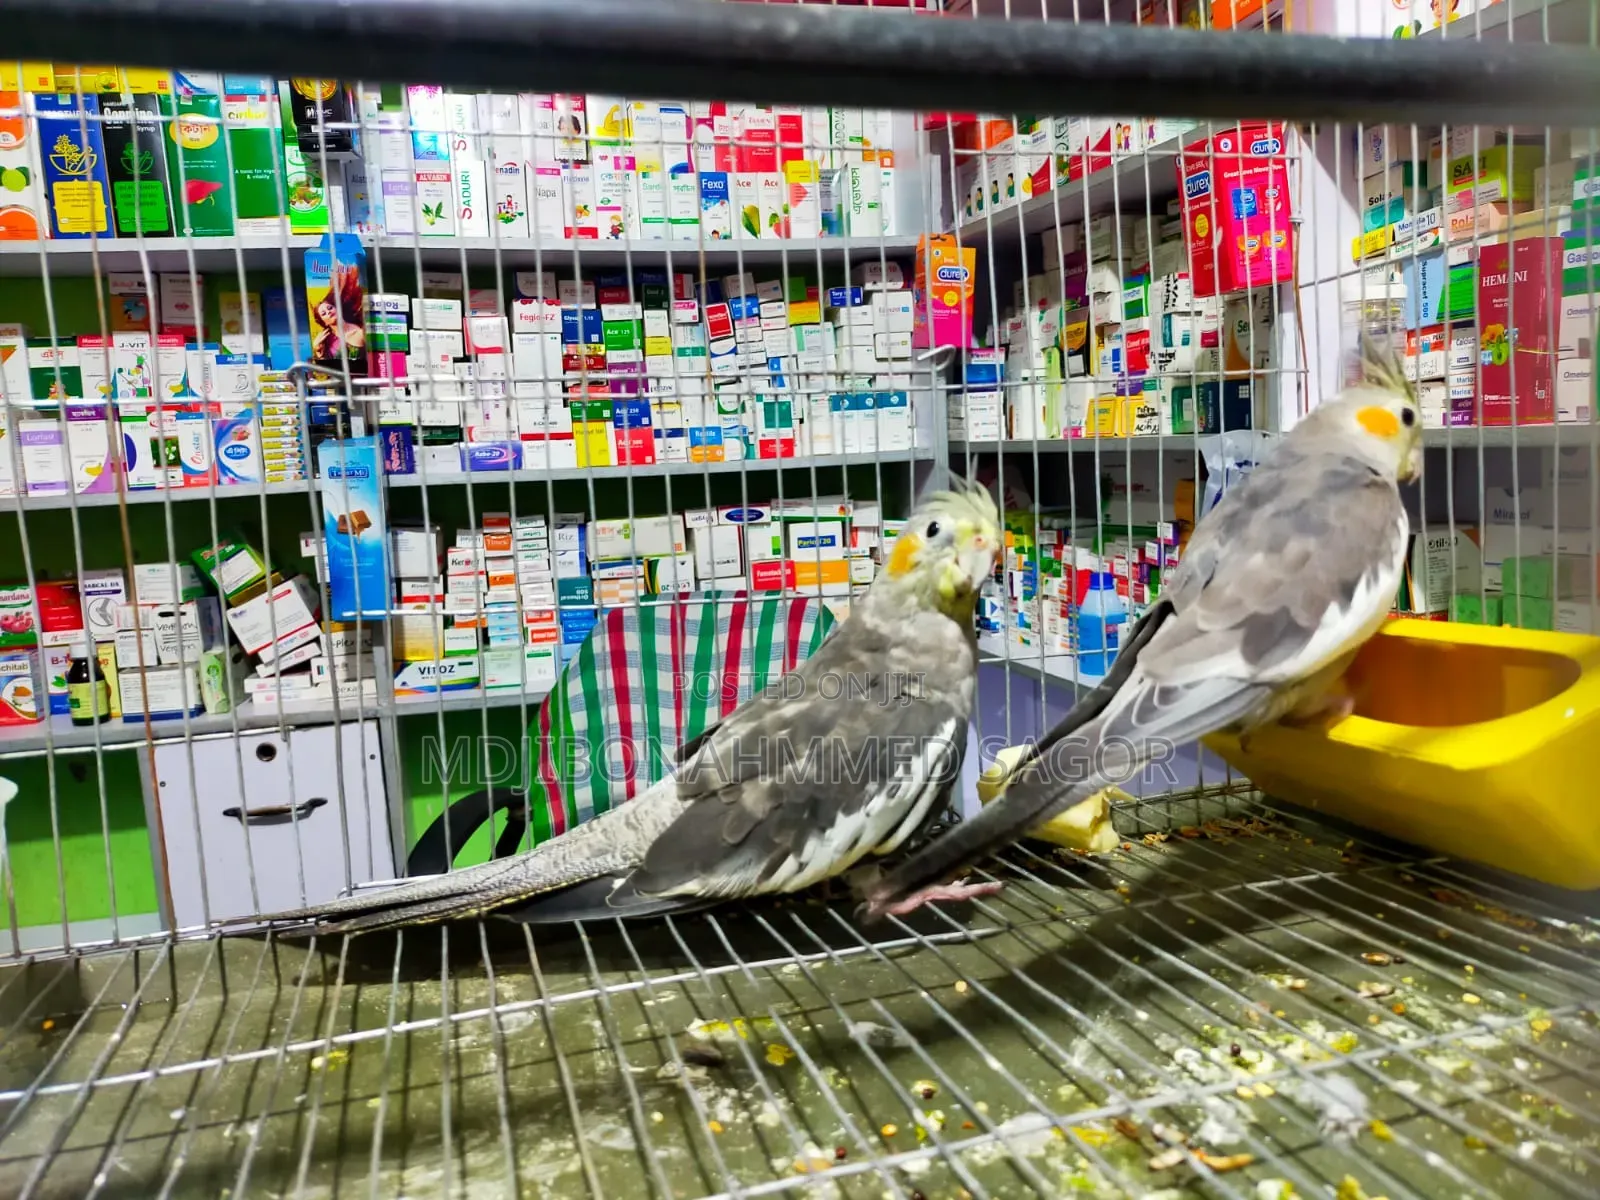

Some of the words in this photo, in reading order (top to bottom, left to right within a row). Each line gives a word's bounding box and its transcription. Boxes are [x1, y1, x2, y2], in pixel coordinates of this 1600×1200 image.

[1252, 141, 1279, 153] durx
[1453, 156, 1487, 178] SAI
[701, 179, 724, 189] Fexo
[459, 171, 473, 220] SADURI
[1482, 270, 1527, 287] HEMNI
